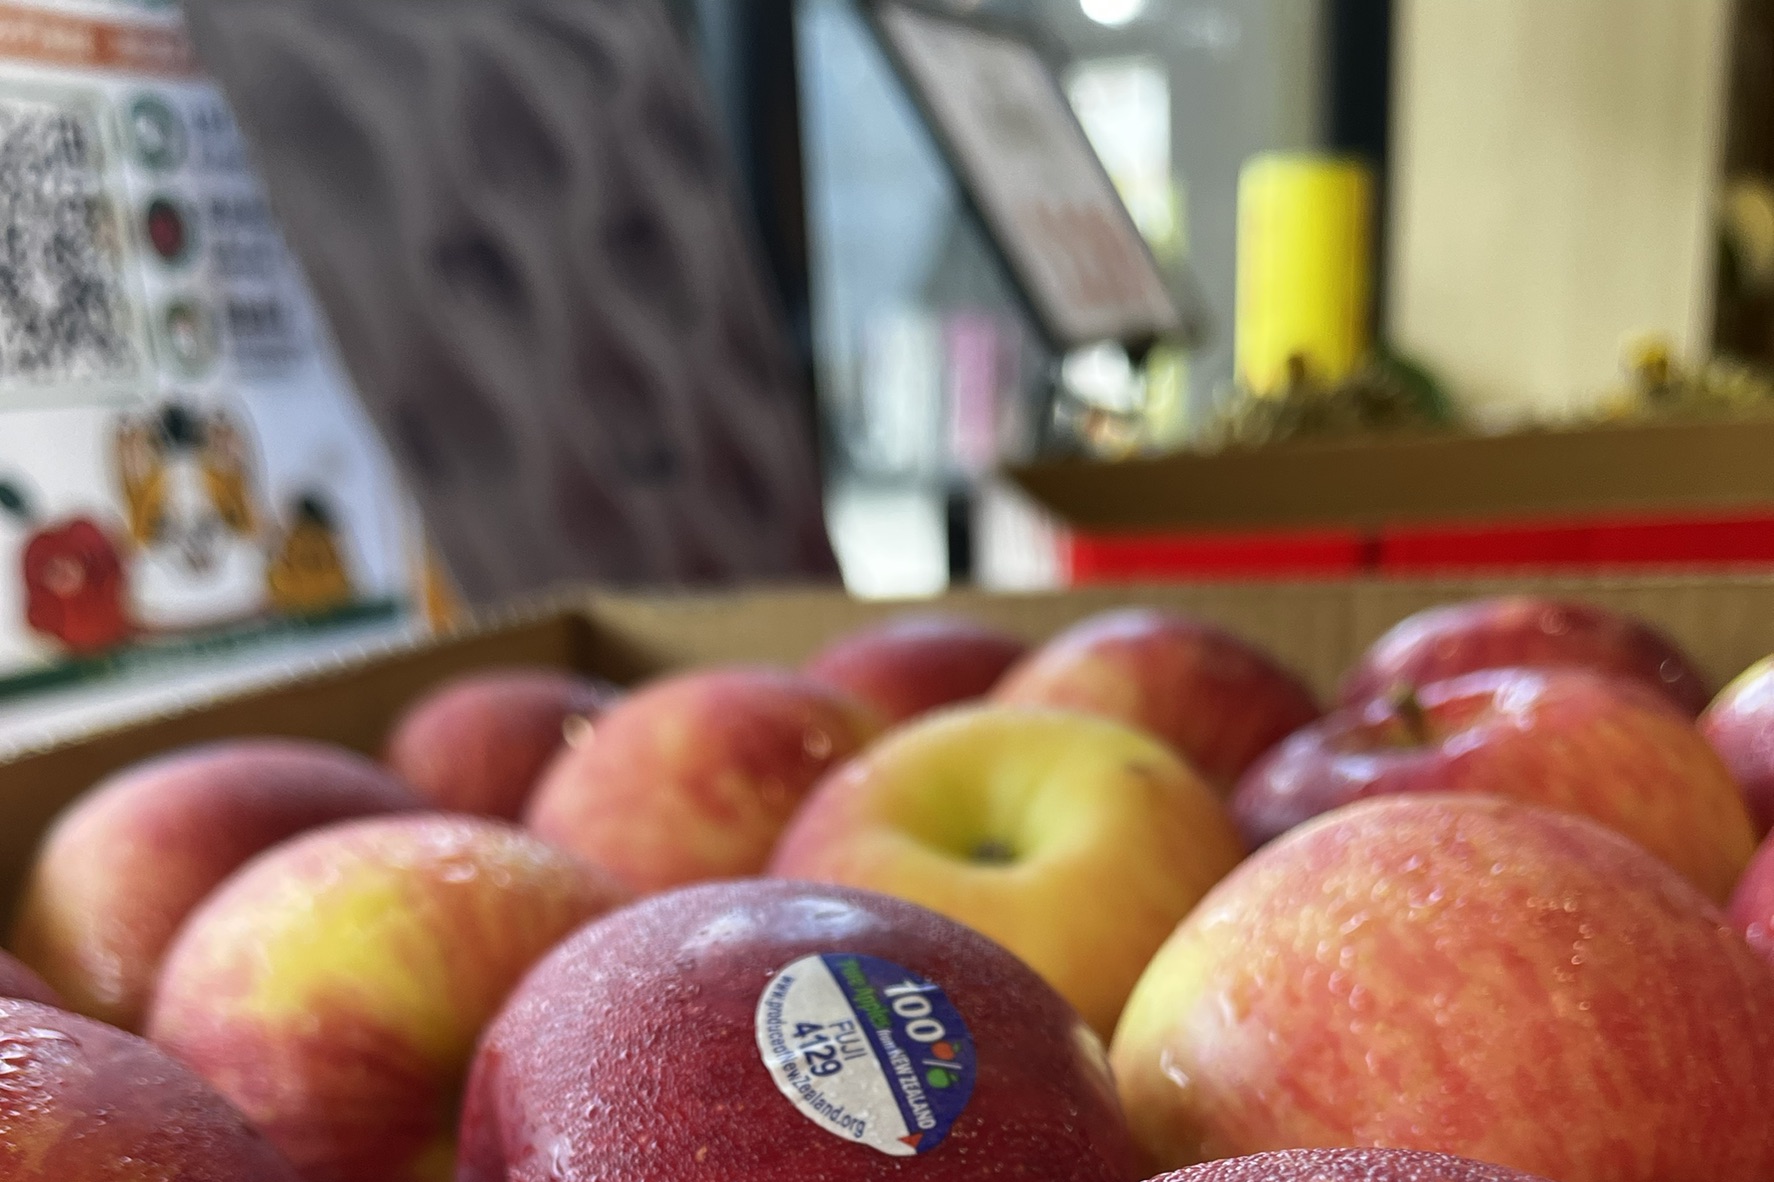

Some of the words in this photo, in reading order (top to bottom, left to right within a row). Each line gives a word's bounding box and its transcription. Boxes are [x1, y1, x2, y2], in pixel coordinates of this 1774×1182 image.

[792, 1022, 842, 1078] 4129
[829, 1019, 868, 1061] FUJI
[890, 1048, 918, 1076] NEW
[898, 1073, 937, 1130] ZEALAND
